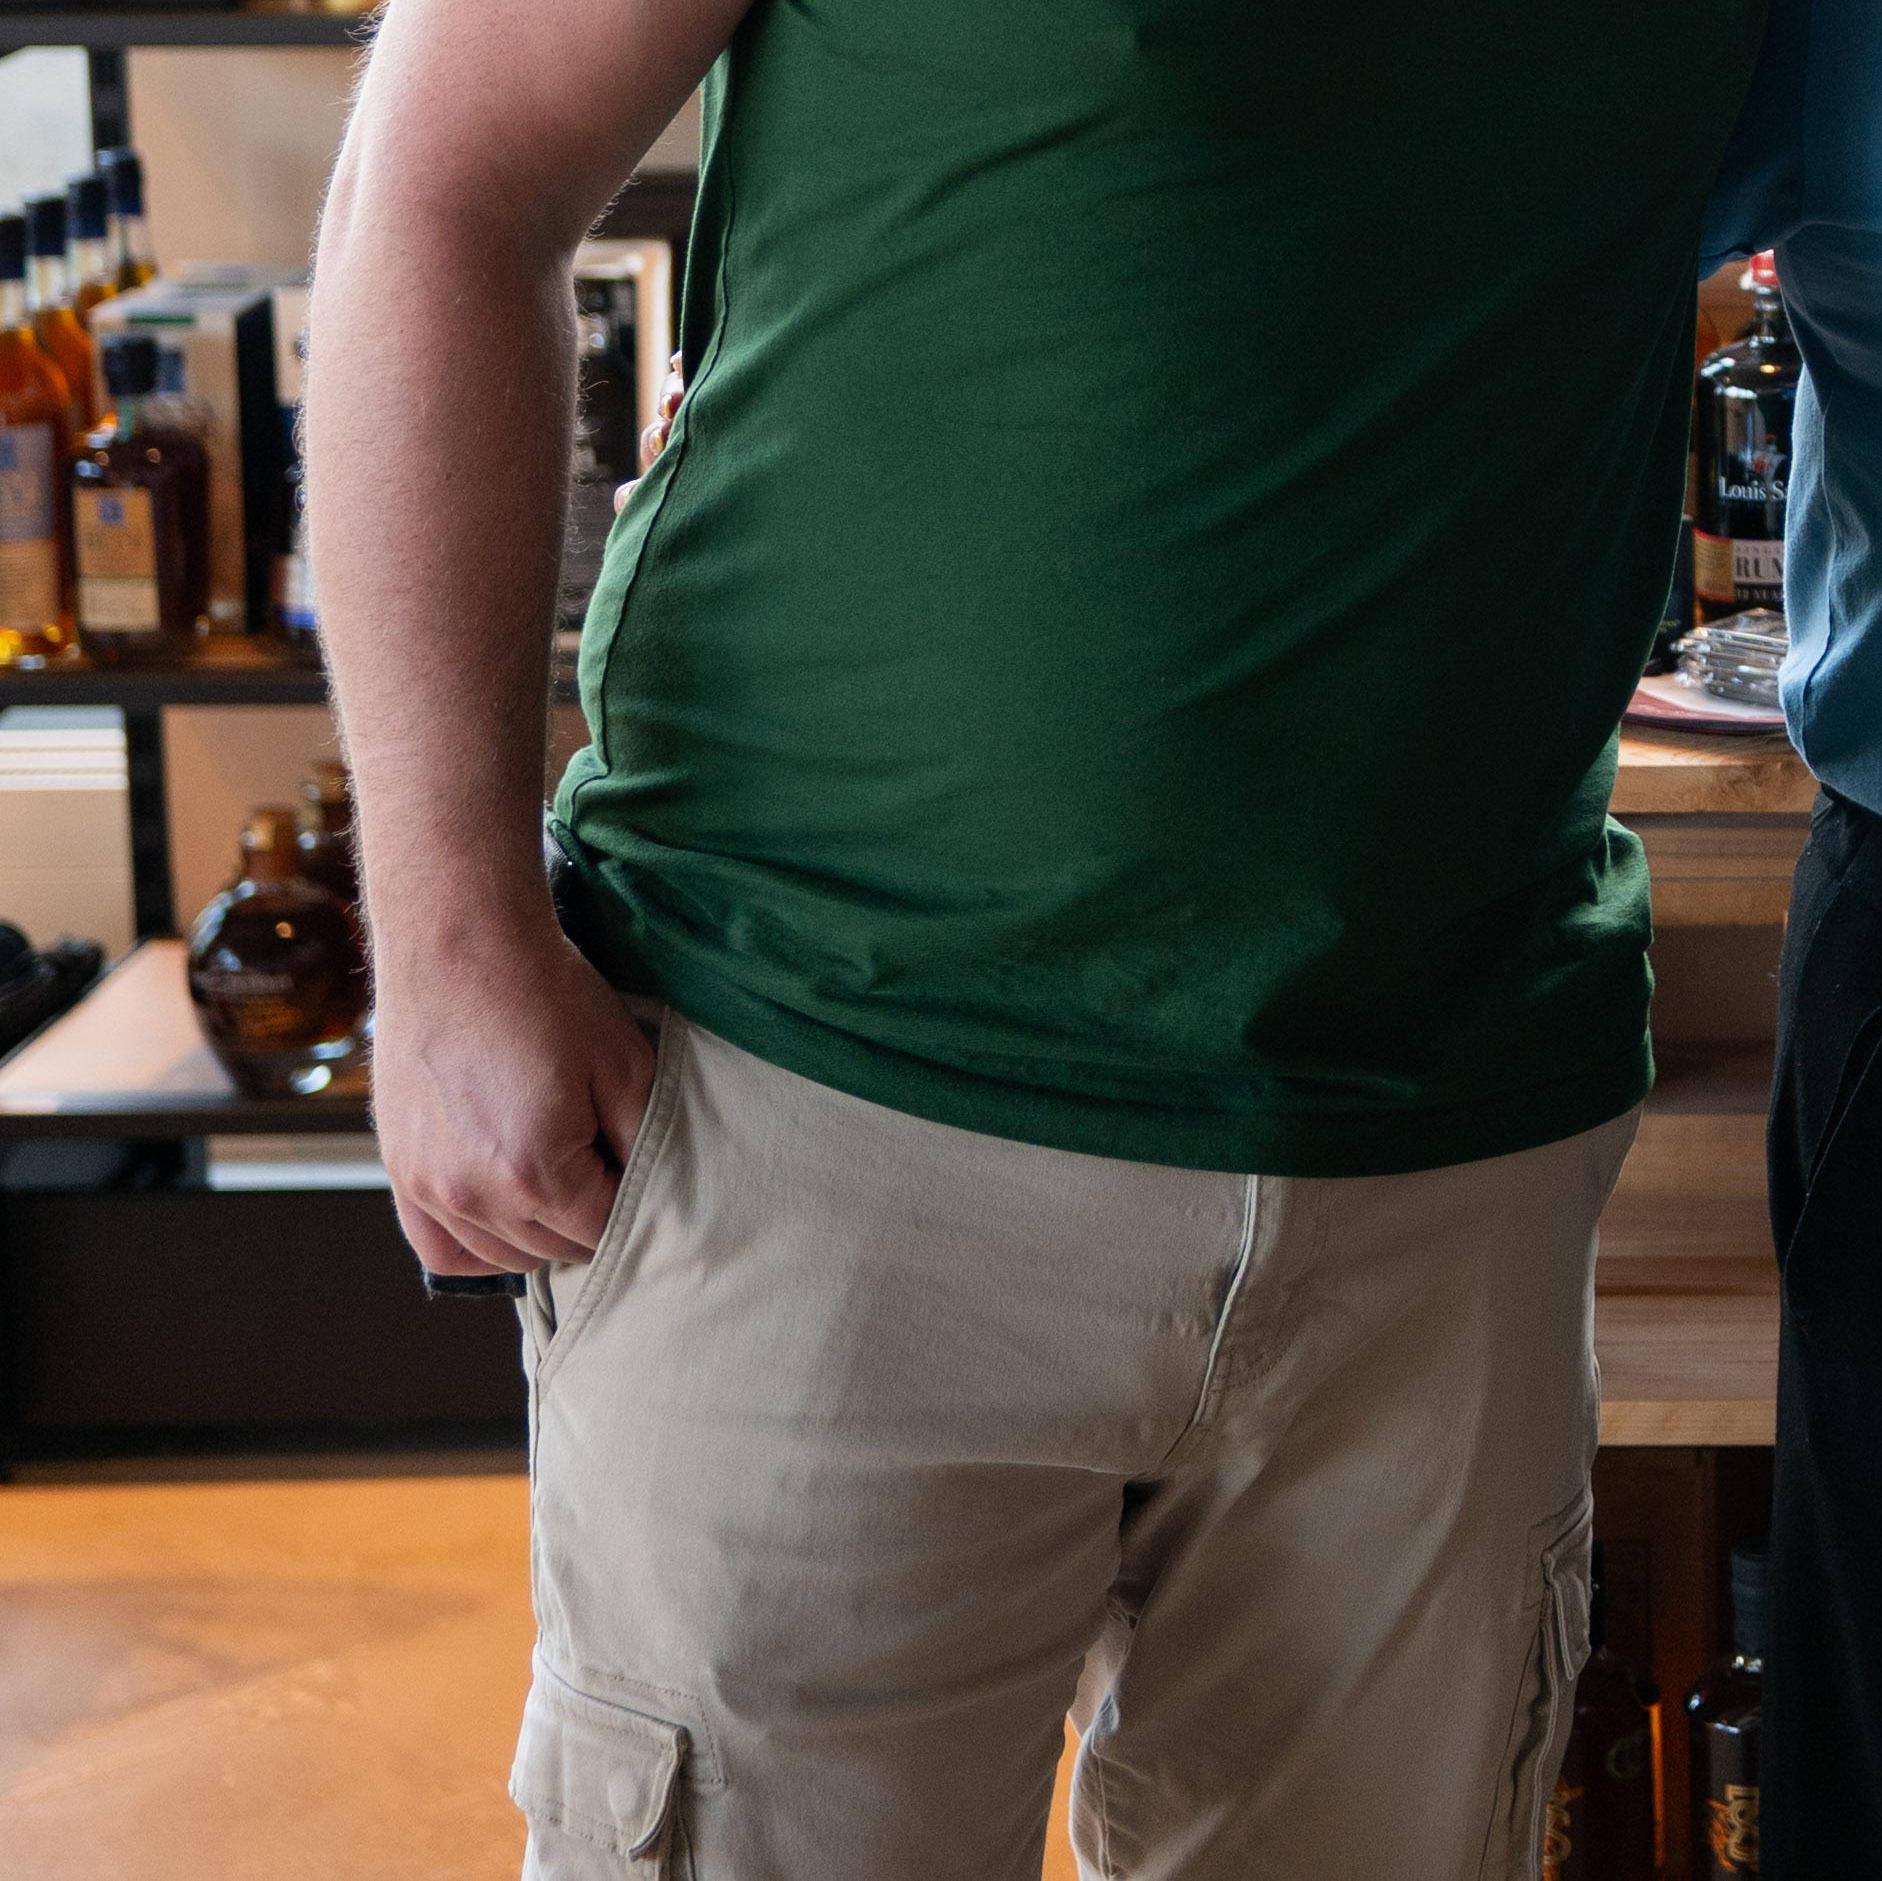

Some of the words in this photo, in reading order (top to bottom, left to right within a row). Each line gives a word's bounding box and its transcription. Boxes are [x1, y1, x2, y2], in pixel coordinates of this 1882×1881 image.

[1718, 475, 1767, 500] Louis
[1771, 480, 1788, 501] S
[1753, 588, 1783, 600] YEA
